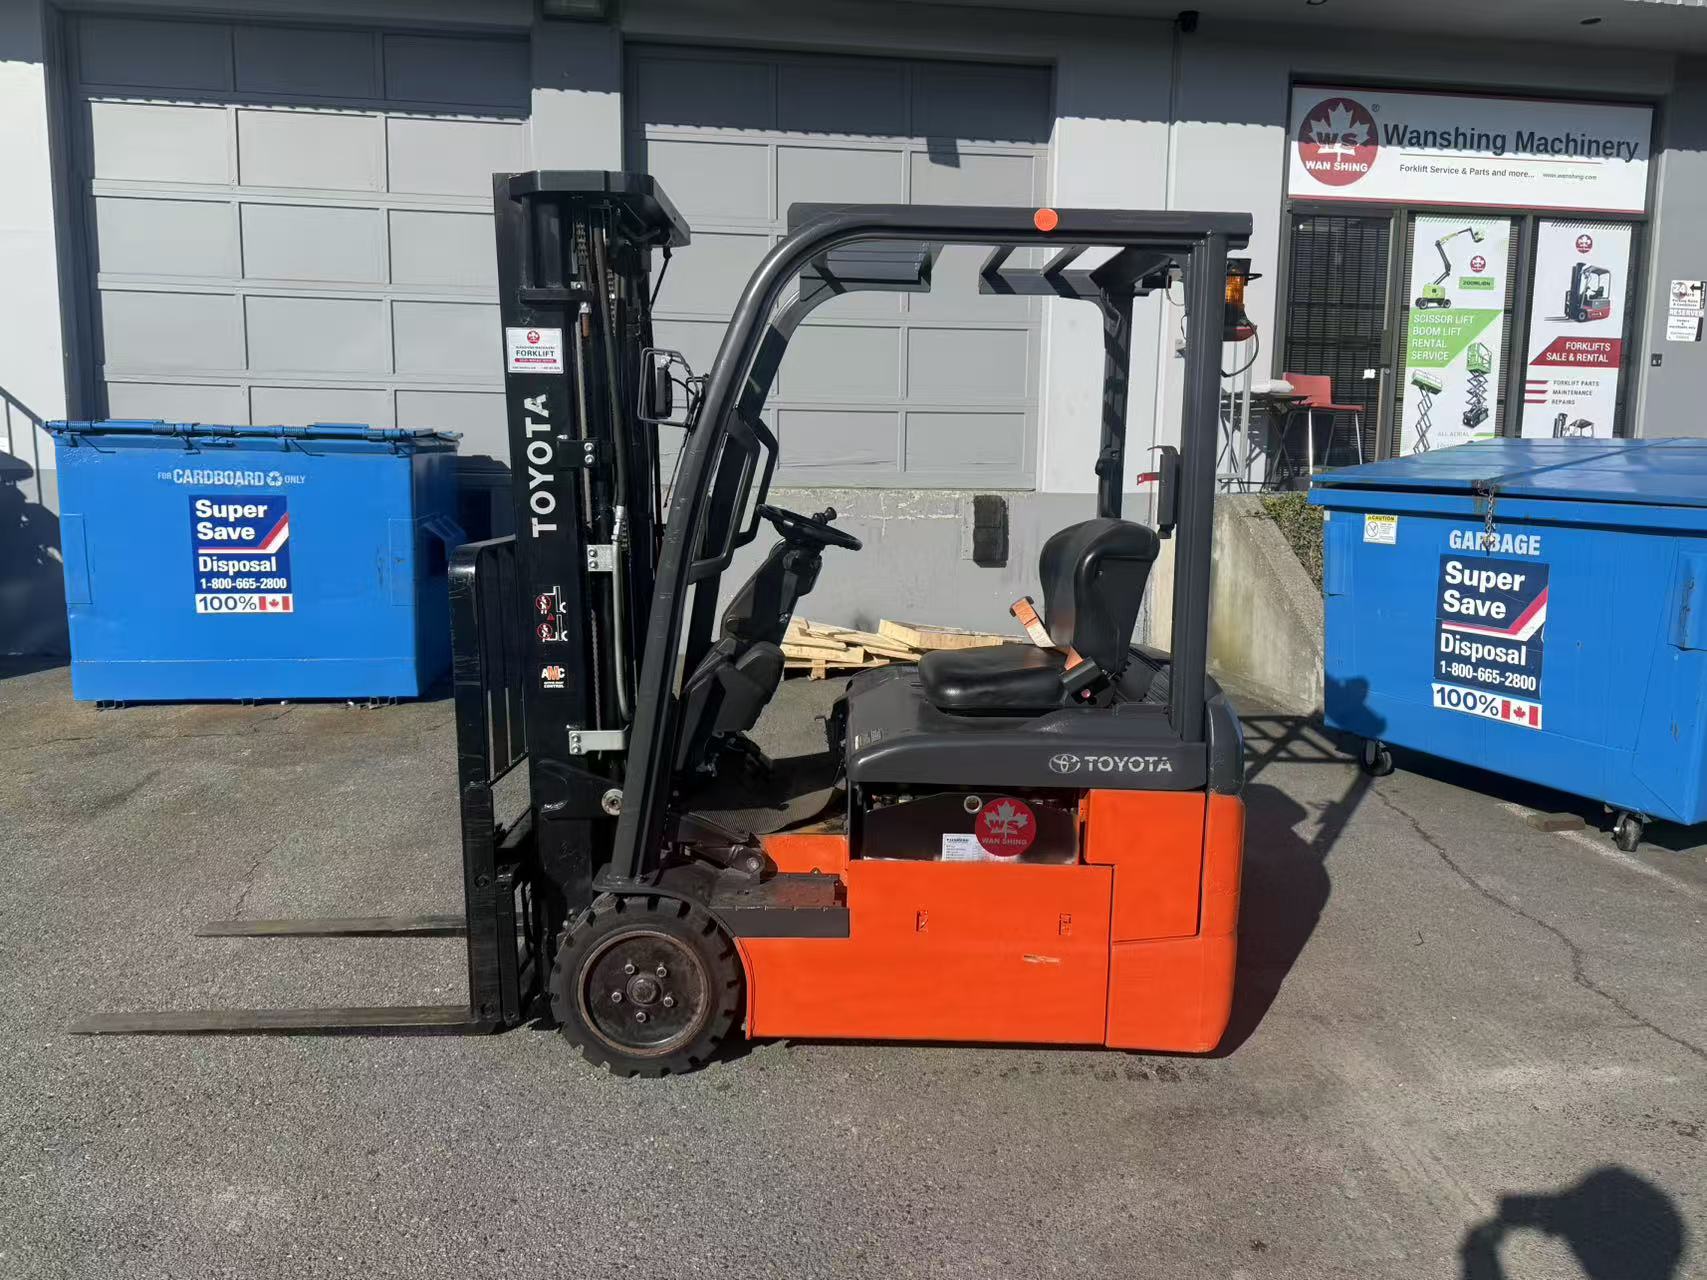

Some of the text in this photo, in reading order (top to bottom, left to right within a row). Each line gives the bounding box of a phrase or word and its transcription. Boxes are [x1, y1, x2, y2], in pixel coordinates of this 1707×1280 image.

[1384, 123, 1639, 163] Wanshing Machinery
[1305, 160, 1368, 172] WAN SHING
[1399, 164, 1428, 173] Forklift
[1430, 165, 1459, 175] Service
[1461, 167, 1467, 175] &
[1469, 168, 1490, 176] Parts
[1491, 169, 1507, 177] and
[1414, 314, 1475, 324] SCISSOR LIFT
[1413, 326, 1462, 336] BOOM LIFT
[1412, 339, 1447, 348] RENTAL
[1566, 341, 1611, 352] FORKLIFTS
[516, 349, 555, 357] FORKLIFT
[1411, 351, 1450, 360] SERVICE
[1546, 352, 1608, 363] SALE & RENTAL
[523, 394, 558, 538] TOYOTA
[157, 468, 306, 486] FOR CARDBOARD ONLY
[195, 499, 268, 522] Super
[197, 521, 256, 540] Save
[1449, 529, 1541, 556] GARBAGE
[198, 556, 277, 576] Disposal
[200, 577, 287, 589] 1-800-665-2800
[1445, 560, 1526, 593] Super
[198, 595, 257, 611] 100%
[1443, 589, 1507, 619] Save
[1440, 632, 1527, 666] Disposal
[1440, 660, 1537, 691] 1-800-665-2800
[1436, 686, 1499, 716] 100%
[1084, 756, 1173, 772] TOYOTA
[982, 838, 1027, 846] WAN SHING
